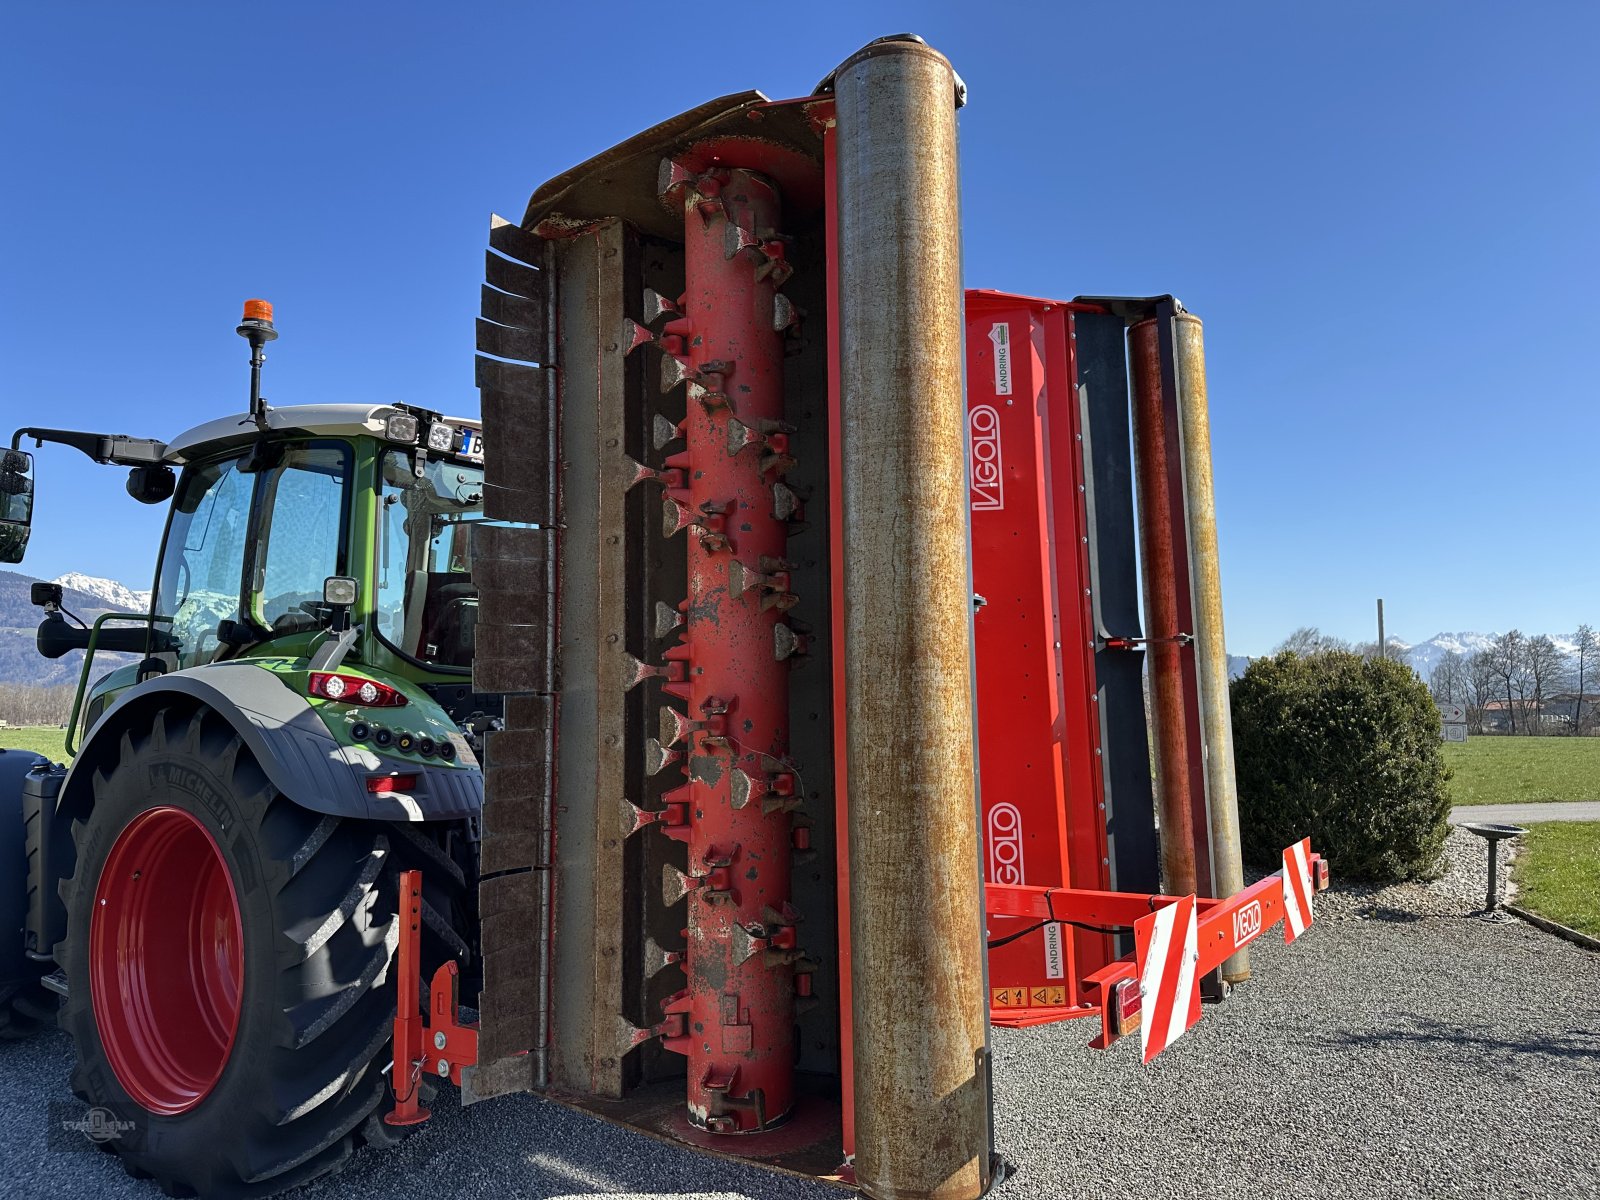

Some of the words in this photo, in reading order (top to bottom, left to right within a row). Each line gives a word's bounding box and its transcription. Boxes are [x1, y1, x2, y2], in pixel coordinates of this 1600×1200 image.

[999, 347, 1008, 394] LANDRING
[970, 406, 1004, 510] VIGOLO
[168, 766, 234, 831] MICHELIN
[990, 805, 1022, 886] GOLO
[1047, 925, 1059, 977] LANDRING
[1232, 899, 1262, 948] VIGOLO
